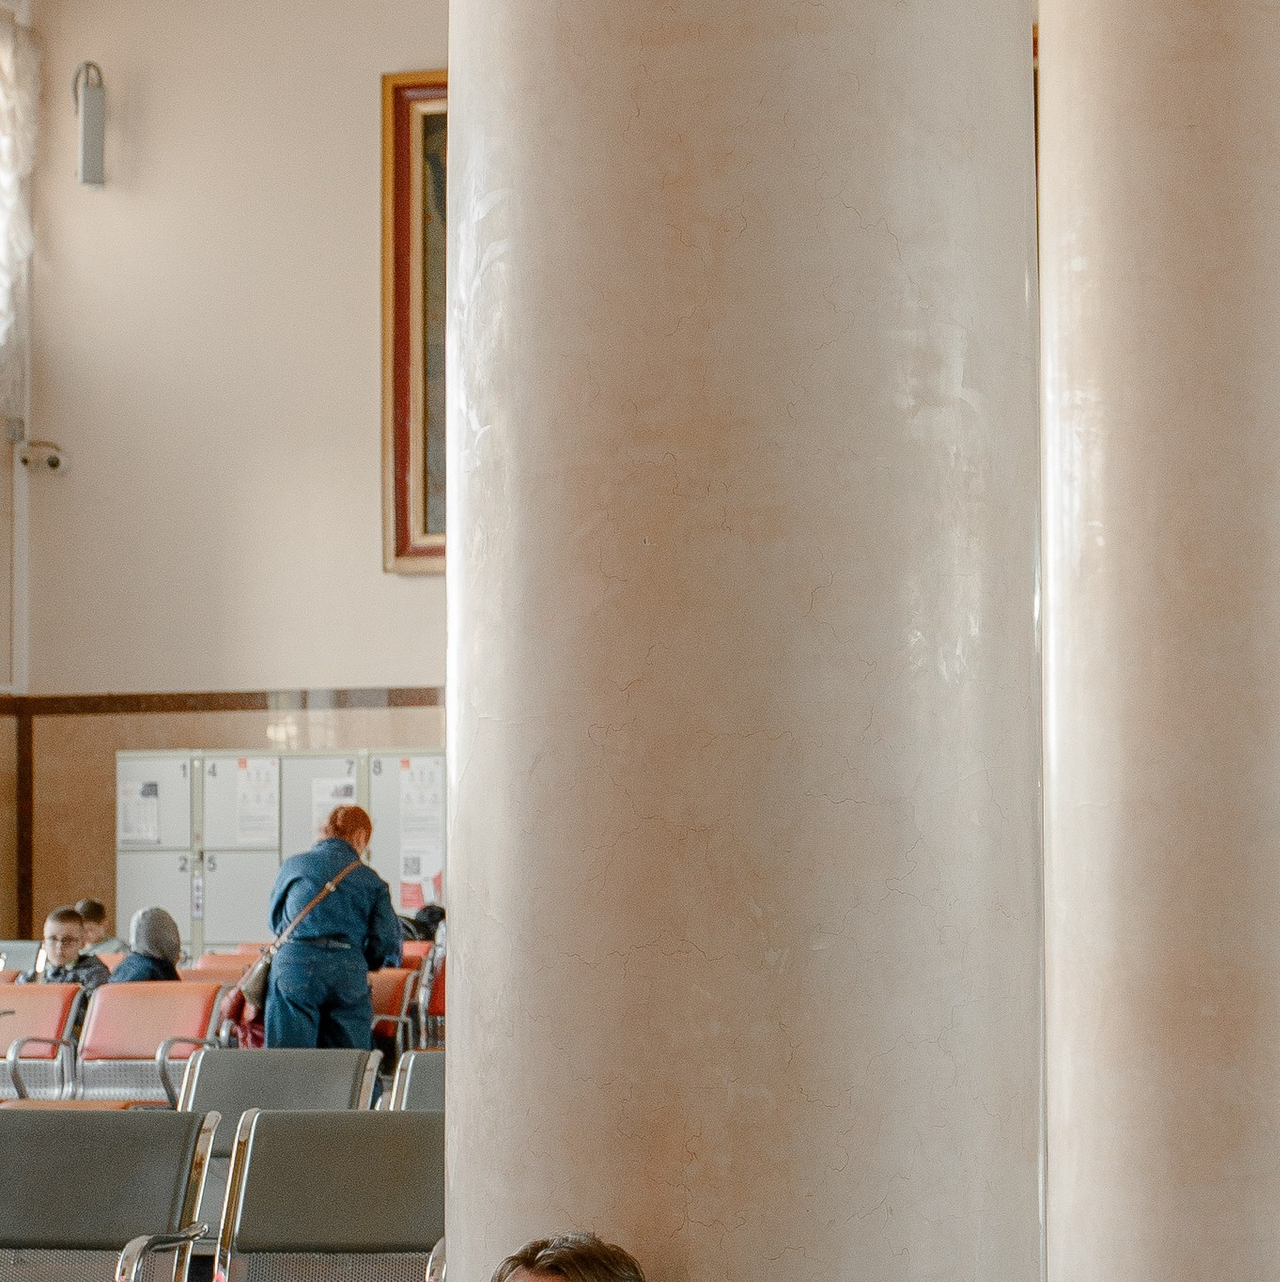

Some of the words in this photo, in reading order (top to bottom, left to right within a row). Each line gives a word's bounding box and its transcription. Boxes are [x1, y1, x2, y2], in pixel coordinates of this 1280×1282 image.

[179, 762, 188, 778] 1
[207, 763, 218, 778] 4
[345, 759, 355, 775] 7
[372, 759, 383, 776] 8
[178, 855, 188, 872] 2
[207, 856, 218, 872] 5
